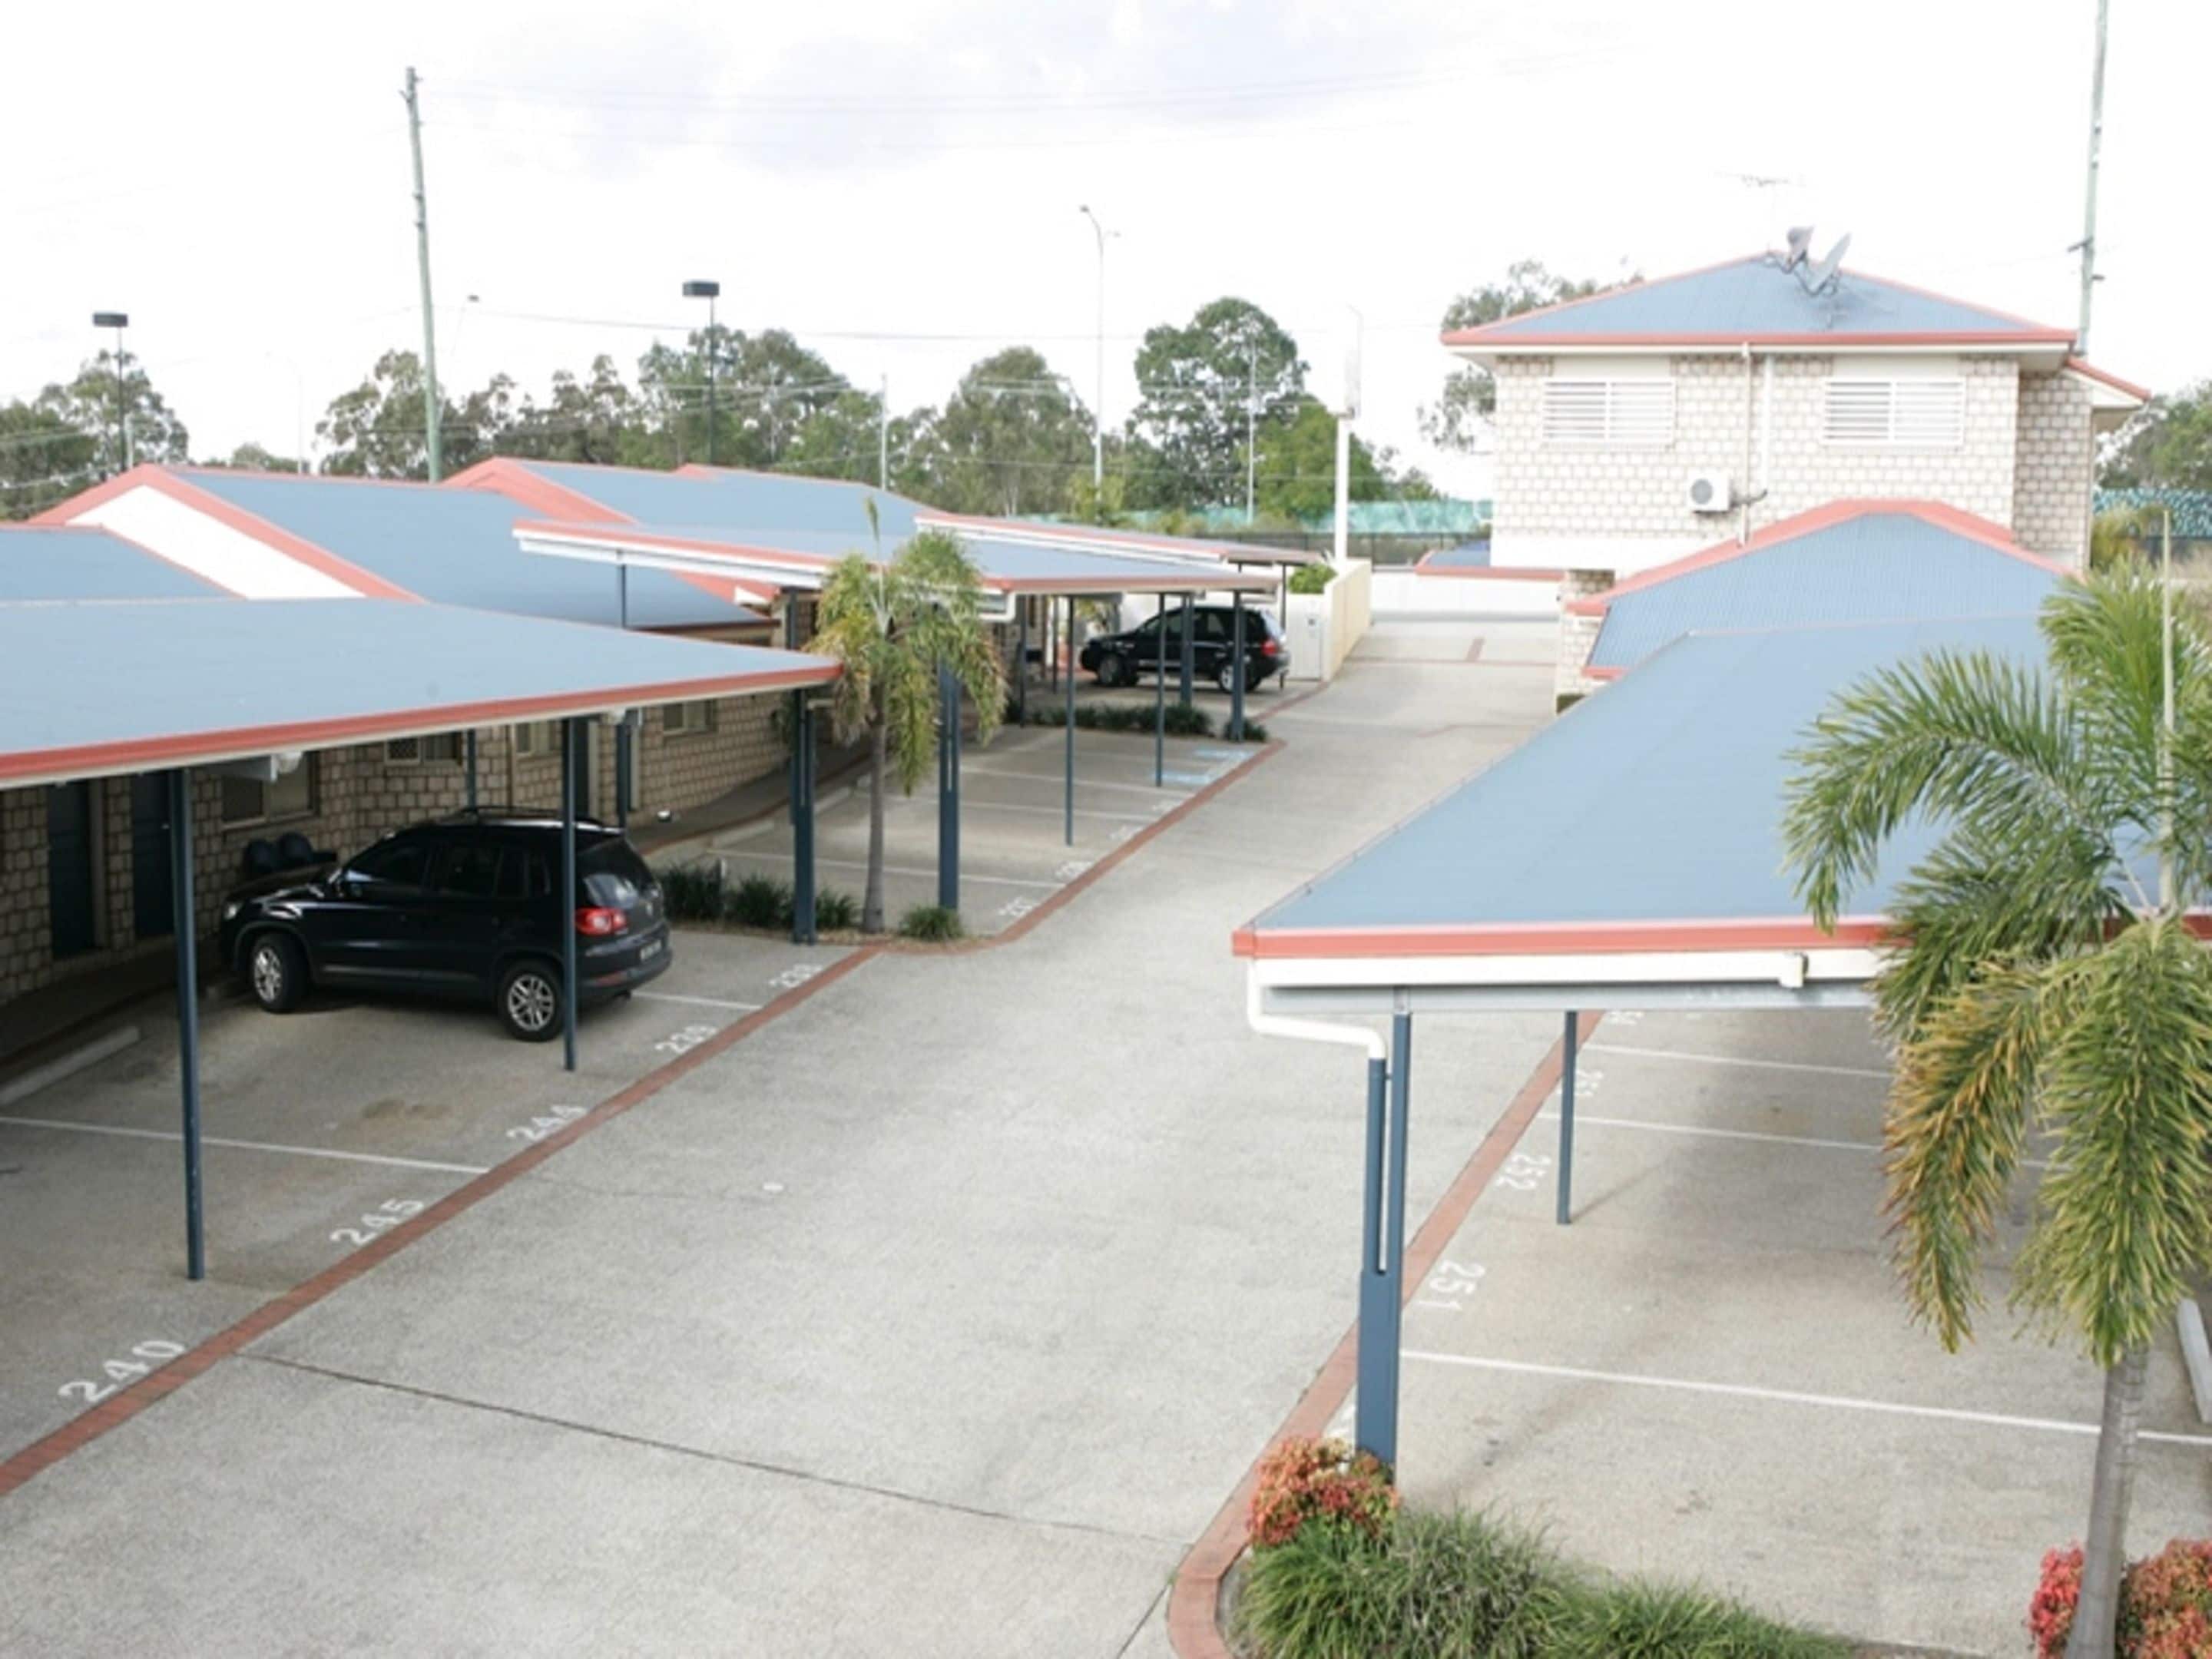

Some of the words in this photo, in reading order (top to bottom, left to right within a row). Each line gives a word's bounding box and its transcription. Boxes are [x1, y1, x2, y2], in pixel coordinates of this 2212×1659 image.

[505, 1104, 588, 1142] 244
[1494, 1155, 1552, 1191] 252
[329, 1197, 424, 1247] 245
[1418, 1260, 1487, 1310] 251
[58, 1339, 187, 1403] 240
